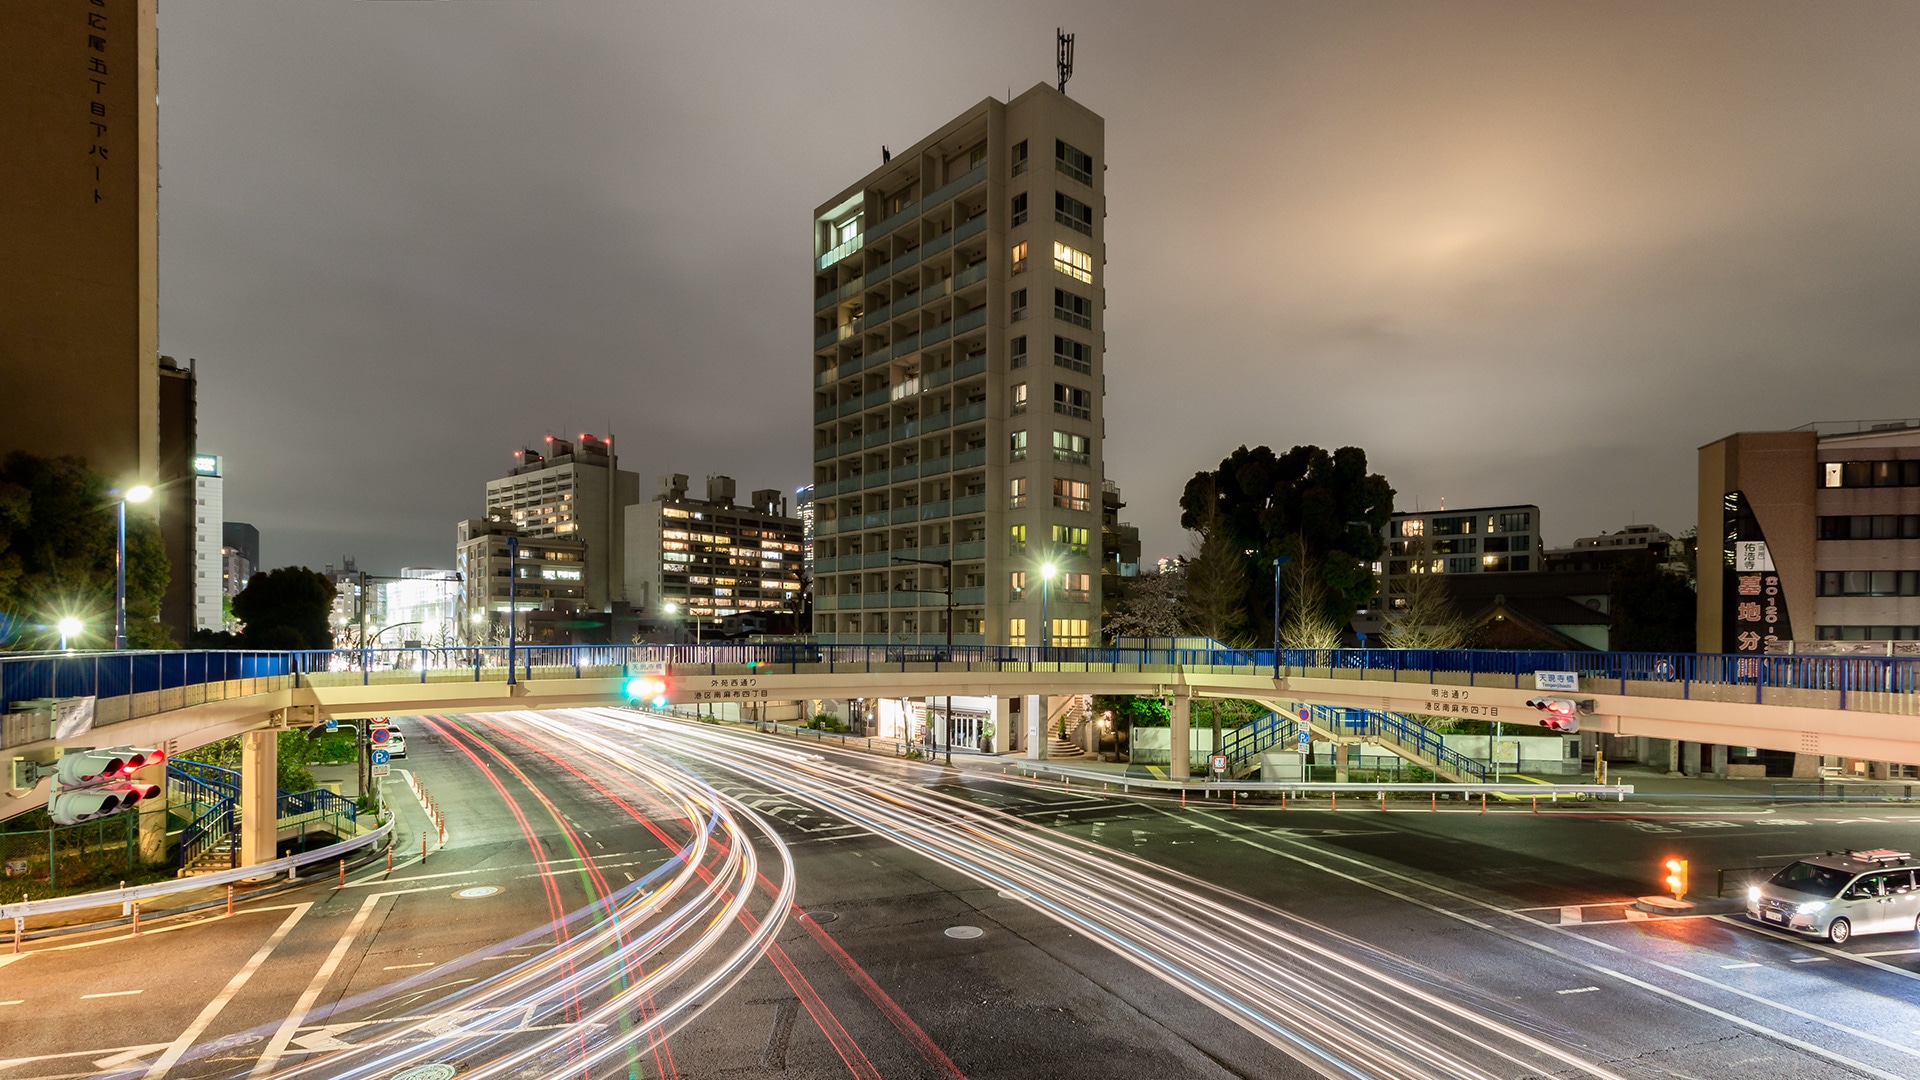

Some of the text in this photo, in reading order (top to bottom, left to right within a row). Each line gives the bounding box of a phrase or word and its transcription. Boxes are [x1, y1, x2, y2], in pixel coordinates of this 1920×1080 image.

[711, 679, 757, 687] 外苑西通り
[1539, 674, 1574, 683] 天現寺橋
[694, 690, 768, 700] 港区南麻布四丁目
[1431, 688, 1469, 700] 明治通り
[1424, 701, 1498, 717] 港区南麻布四丁目
[376, 753, 383, 762] P
